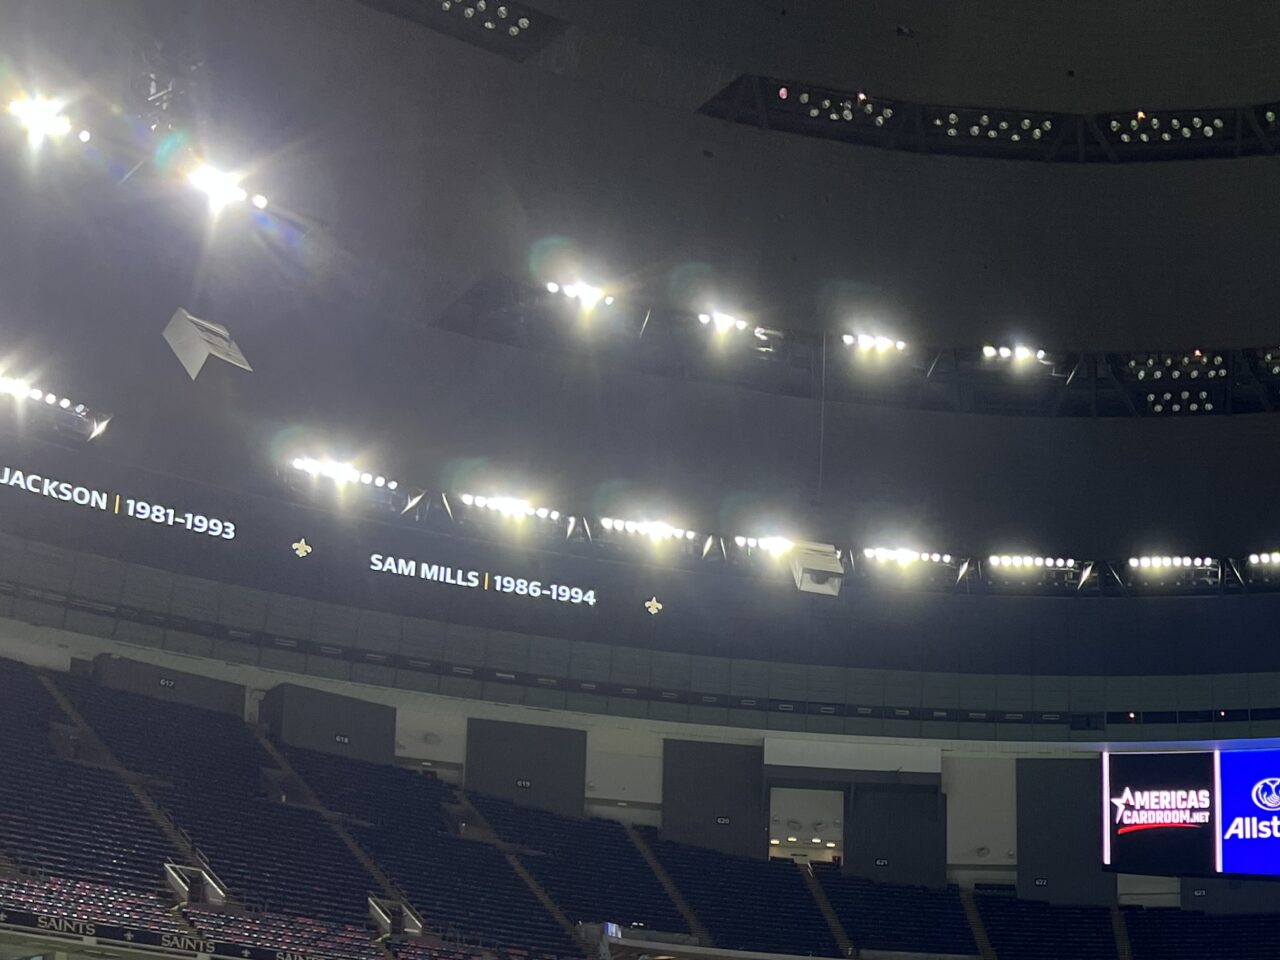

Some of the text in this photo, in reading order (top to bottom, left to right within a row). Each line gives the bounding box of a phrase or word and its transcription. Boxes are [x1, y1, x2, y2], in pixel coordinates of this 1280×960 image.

[0, 466, 107, 510] JACKSON
[370, 553, 416, 577] SAM
[419, 562, 479, 588] MILLS
[1111, 787, 1211, 813] AMERICAS
[1122, 811, 1211, 825] CARDROOM.NET
[37, 915, 96, 936] SAINTS
[161, 934, 215, 953] SAINTS
